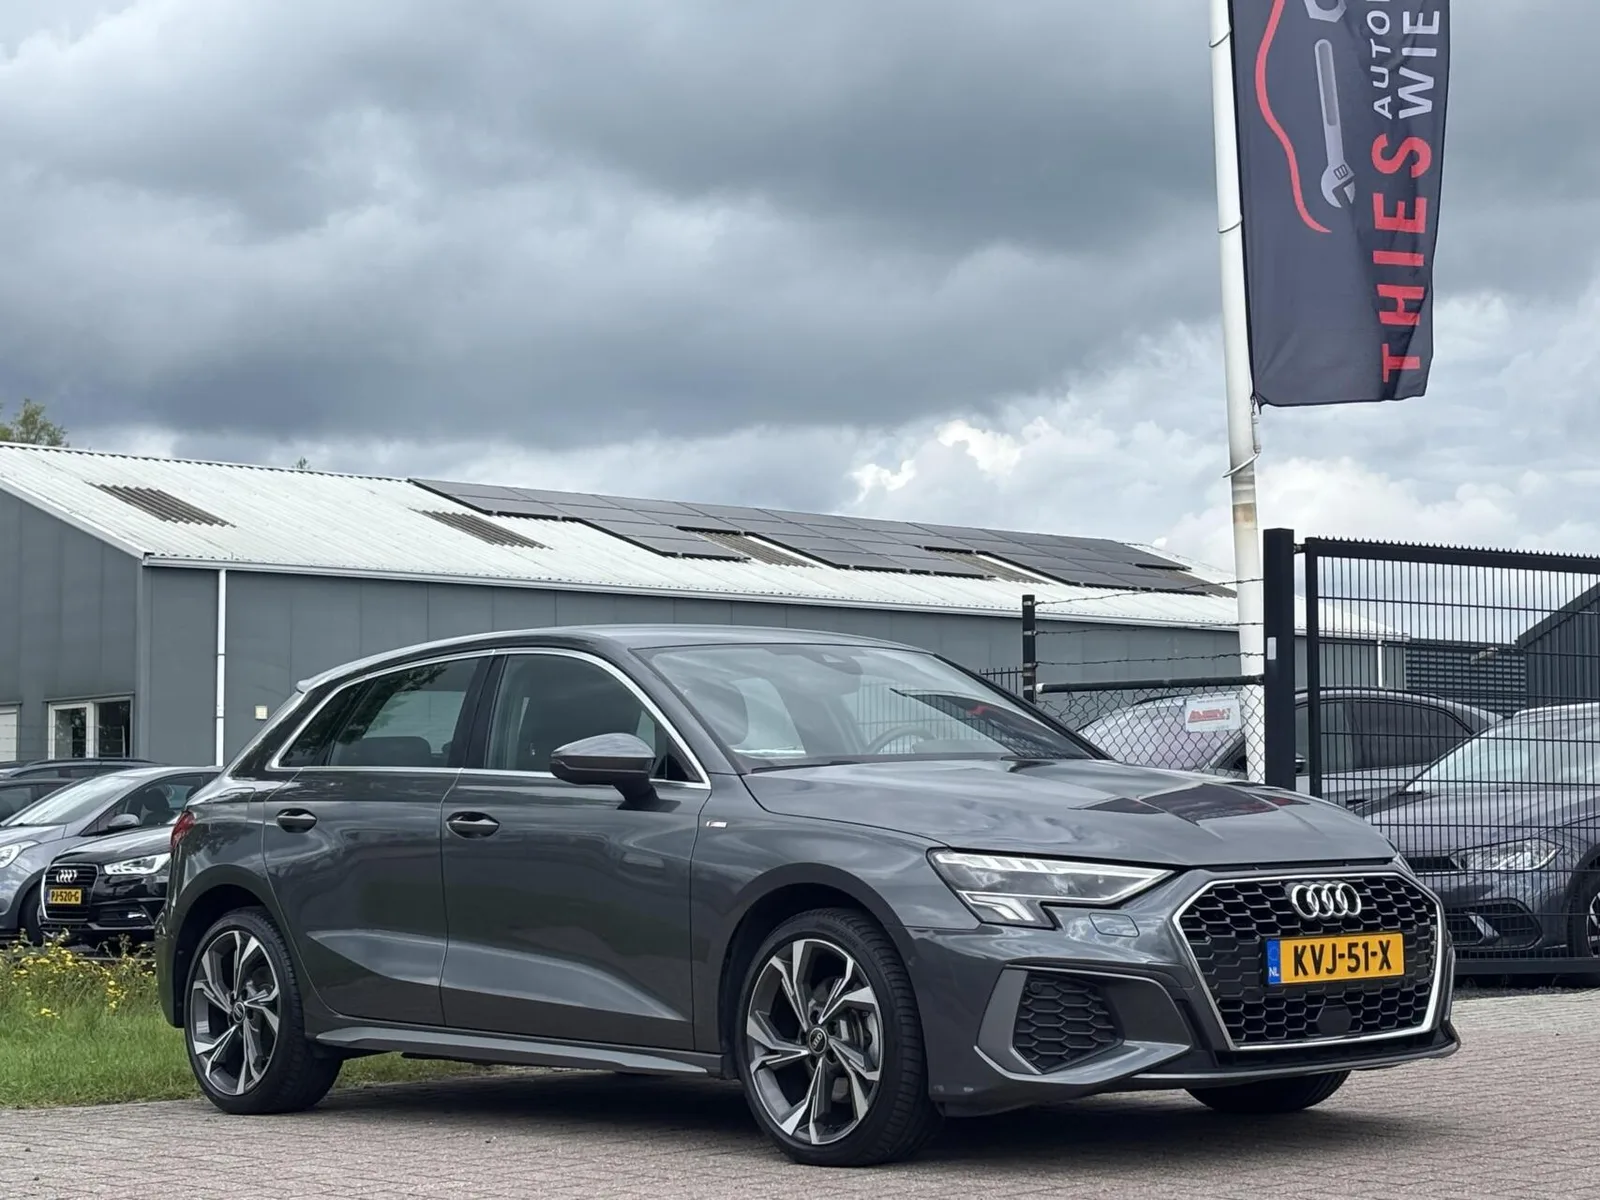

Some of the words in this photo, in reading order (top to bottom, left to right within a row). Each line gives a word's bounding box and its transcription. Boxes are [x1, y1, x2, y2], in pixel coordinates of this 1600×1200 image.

[1366, 0, 1393, 119] AUTO
[1371, 133, 1433, 383] THIES
[51, 890, 80, 902] PJ-520-G
[1268, 966, 1280, 977] NL
[1294, 939, 1392, 977] KVJ-51-X
